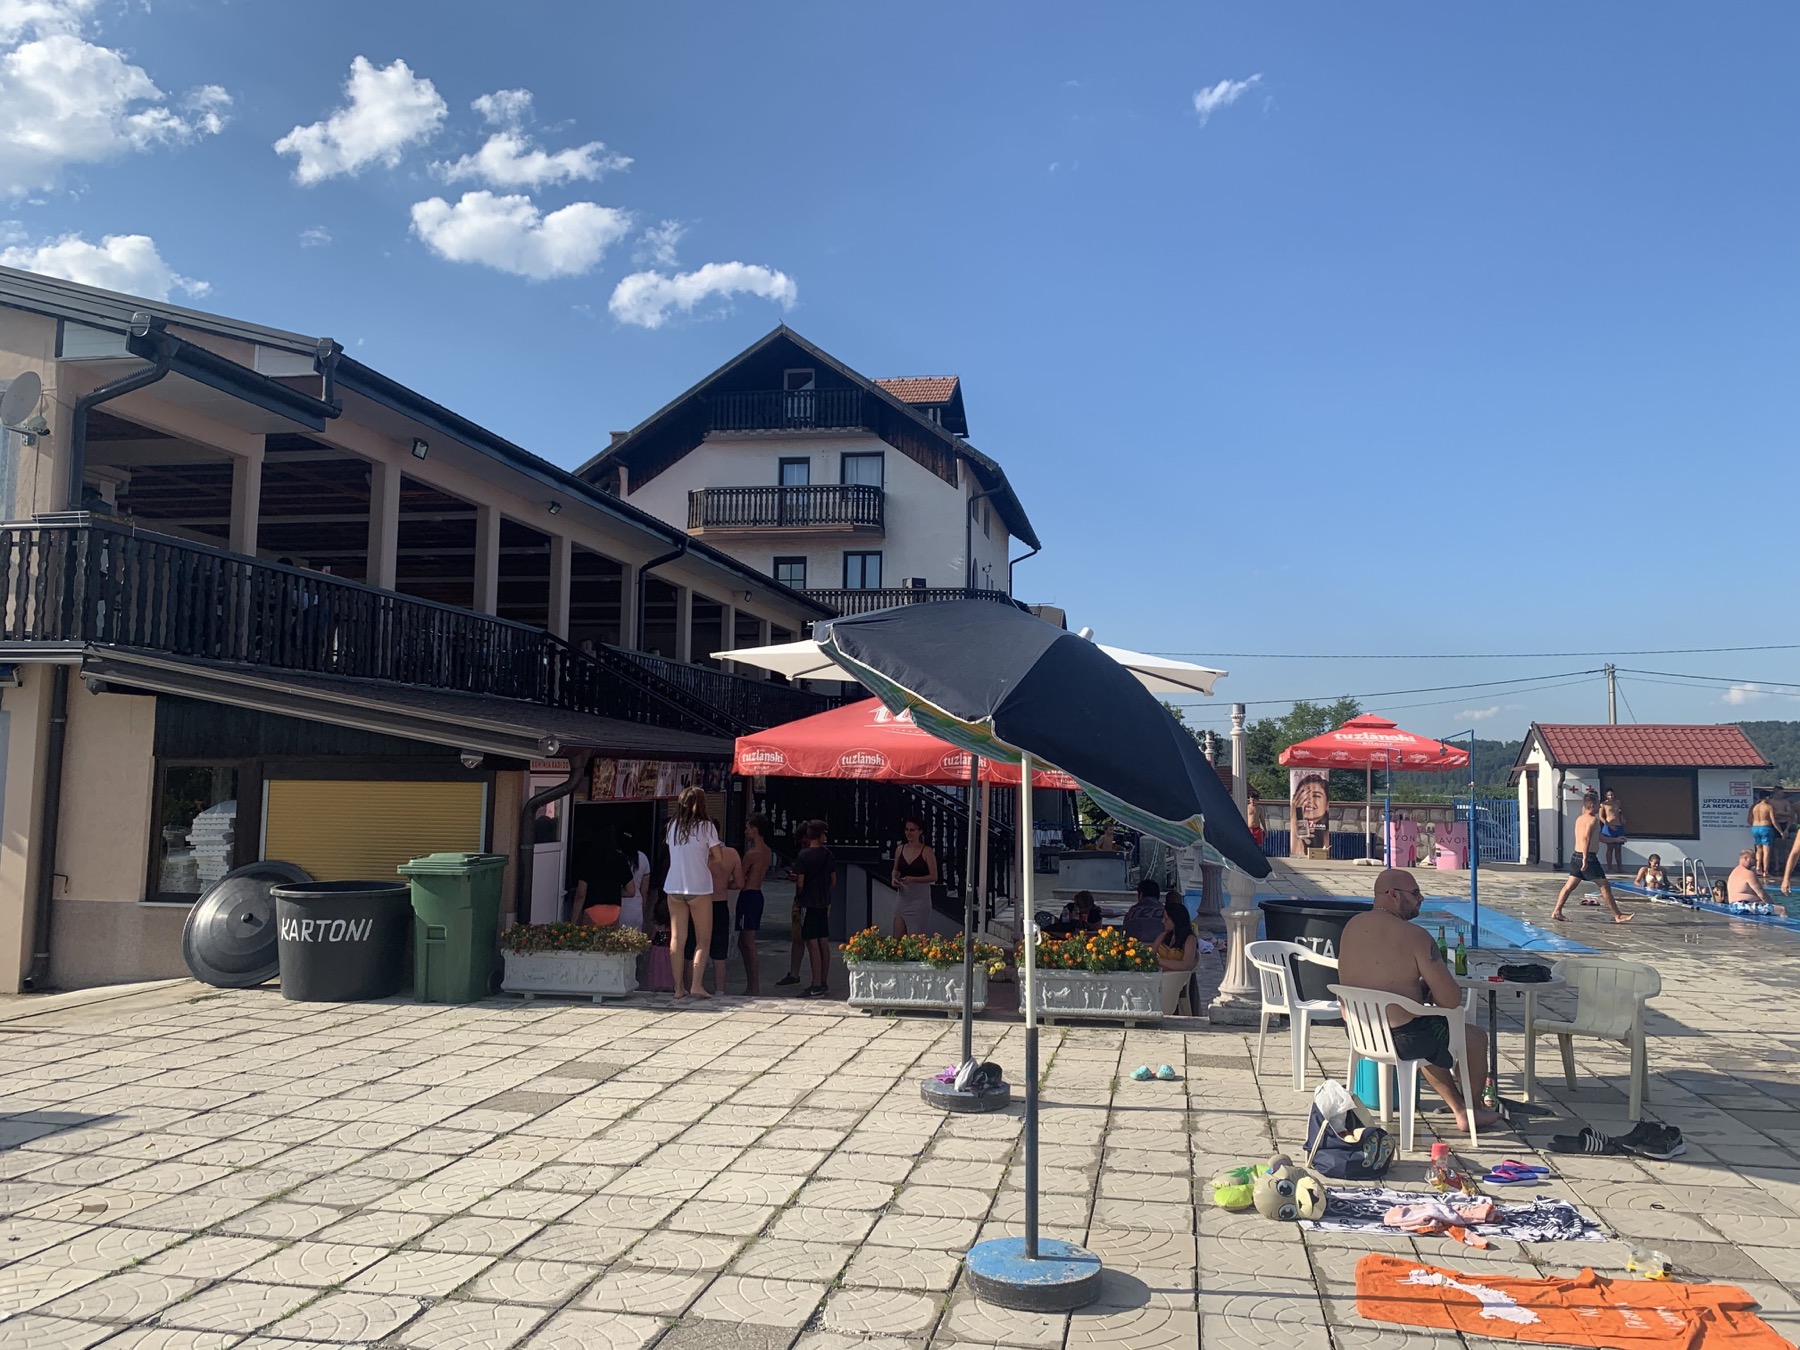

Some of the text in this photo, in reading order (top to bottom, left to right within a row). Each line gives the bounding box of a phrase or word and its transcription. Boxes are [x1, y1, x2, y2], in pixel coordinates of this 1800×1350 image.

[742, 749, 784, 763] tuzlanski
[841, 751, 885, 766] tuzlanski
[1294, 770, 1328, 778] AVON
[1389, 834, 1415, 842] VON
[1439, 836, 1467, 844] AVON
[280, 917, 373, 942] KARTONI
